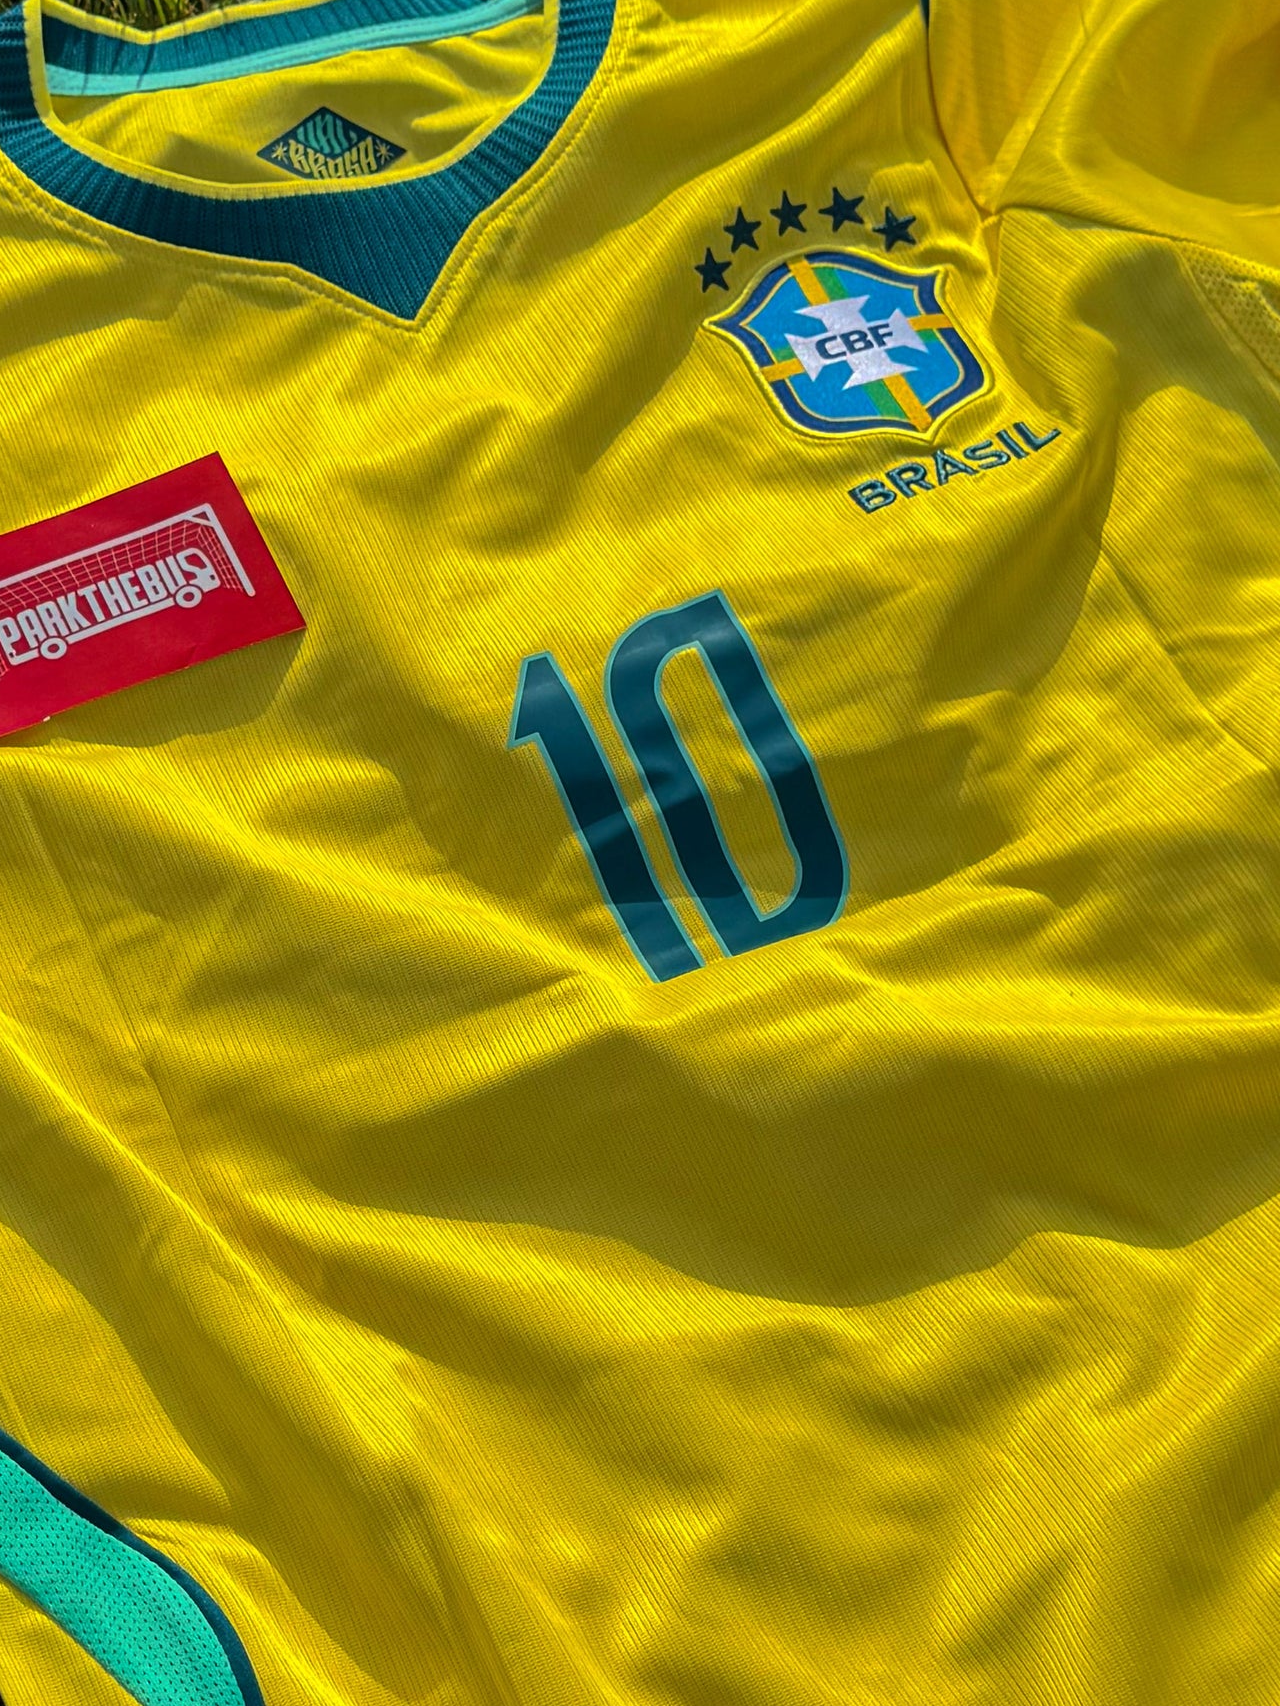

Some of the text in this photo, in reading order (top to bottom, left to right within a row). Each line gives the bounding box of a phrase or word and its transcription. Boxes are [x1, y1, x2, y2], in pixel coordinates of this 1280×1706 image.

[814, 323, 895, 361] CBF
[848, 420, 1061, 514] BRASIL
[507, 588, 850, 983] 10
